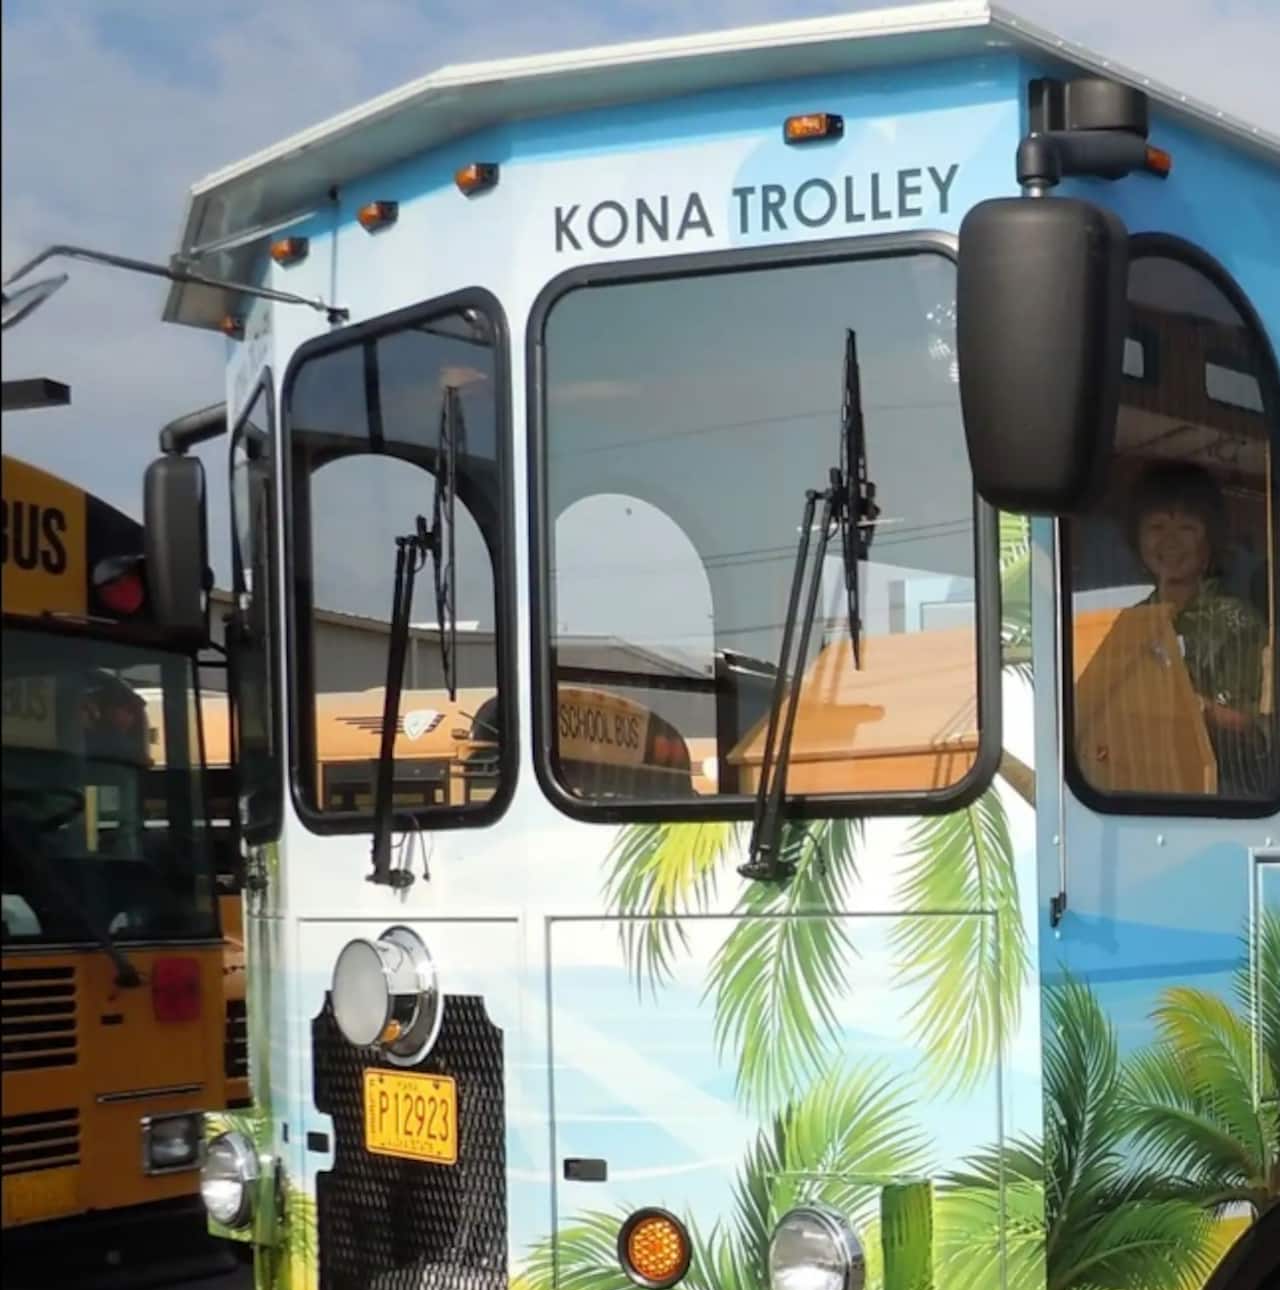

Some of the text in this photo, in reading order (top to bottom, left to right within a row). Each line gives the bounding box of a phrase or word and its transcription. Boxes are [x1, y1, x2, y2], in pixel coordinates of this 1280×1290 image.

[553, 163, 960, 253] KONA TROLLEY
[2, 500, 67, 576] US
[559, 704, 640, 750] SCHOOL BUS
[378, 1090, 450, 1142] P12923
